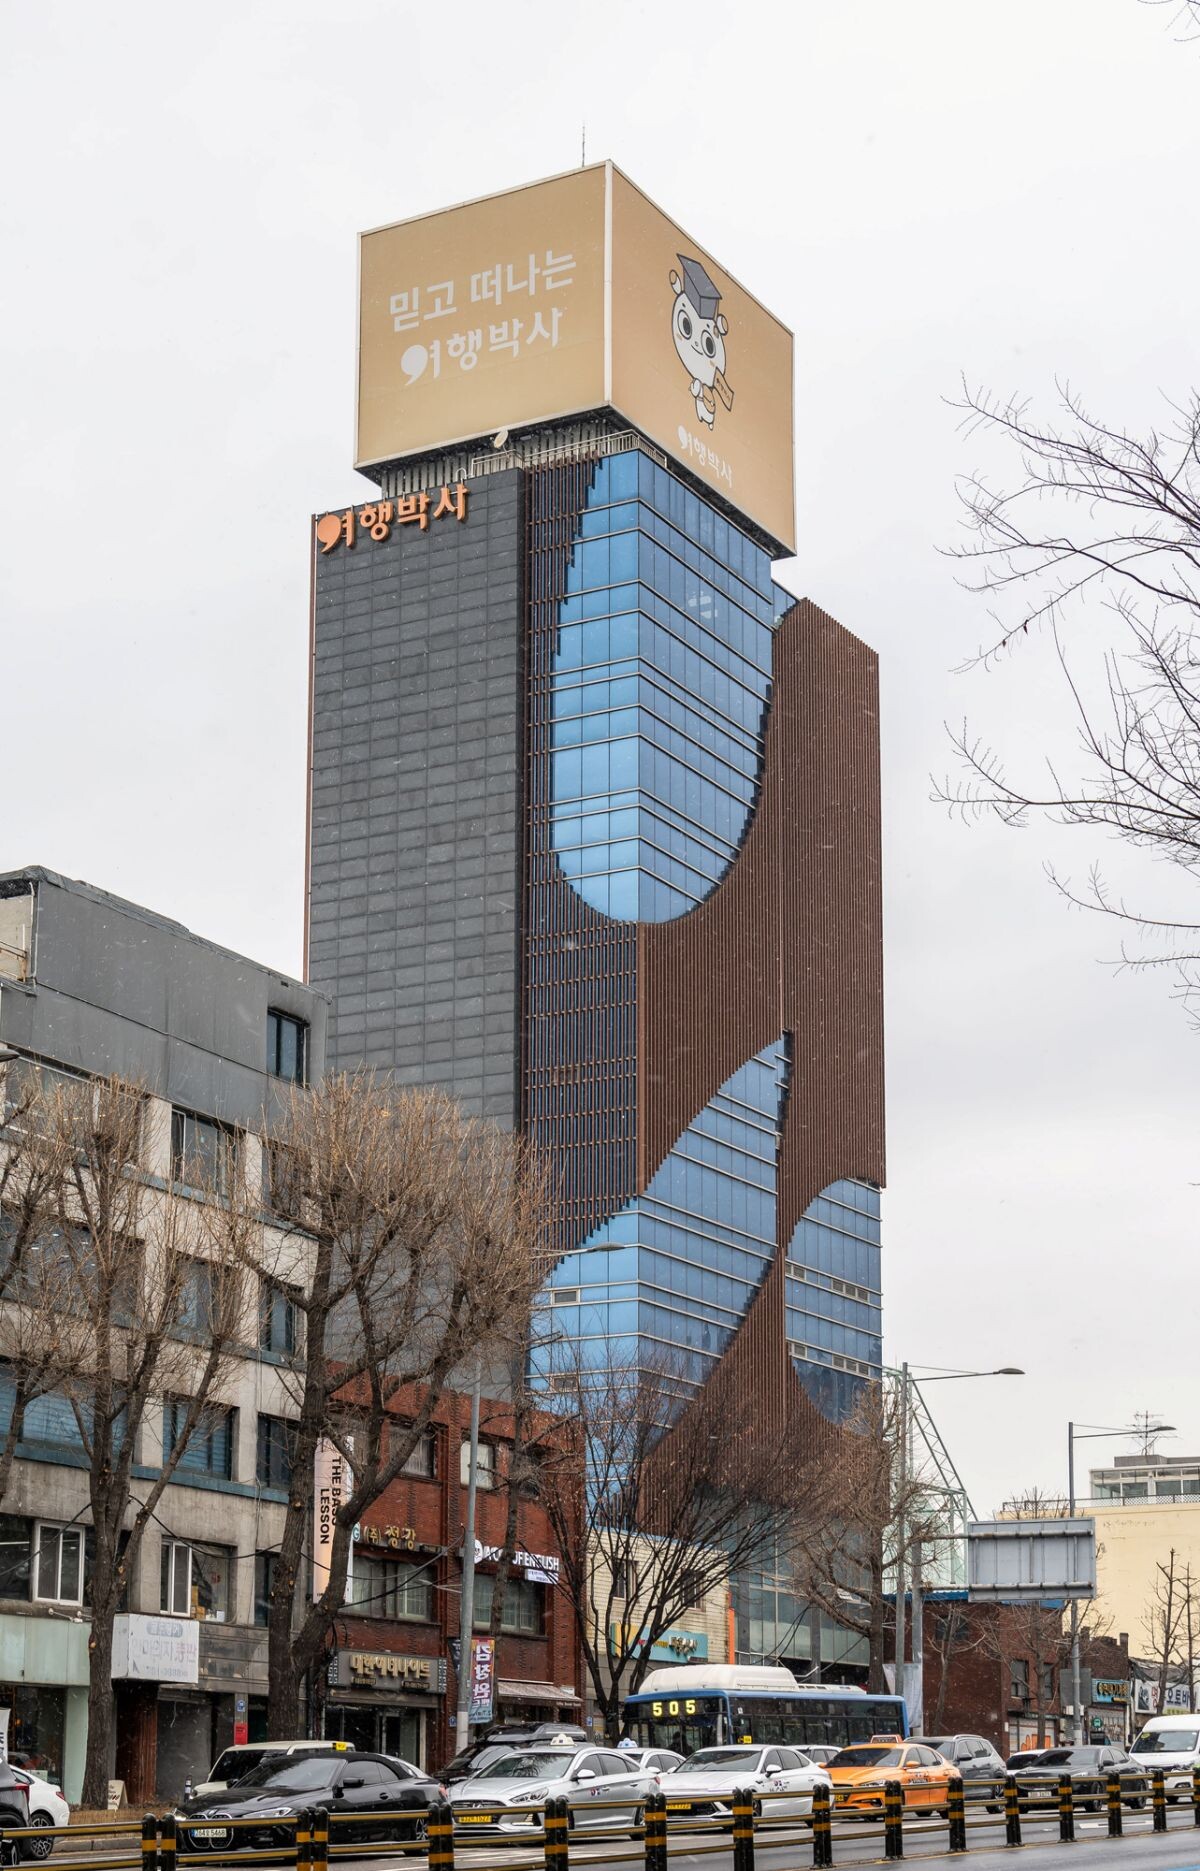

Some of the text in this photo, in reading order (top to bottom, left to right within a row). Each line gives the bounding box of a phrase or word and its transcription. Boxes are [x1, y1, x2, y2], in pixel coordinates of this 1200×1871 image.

[390, 250, 577, 333] 믿고 떠나는
[400, 307, 563, 386] 여행박사
[677, 424, 733, 489] 여행박사
[316, 483, 469, 553] 여행박사
[331, 1456, 342, 1485] THE
[320, 1488, 330, 1544] LESSON
[652, 1700, 697, 1717] 505
